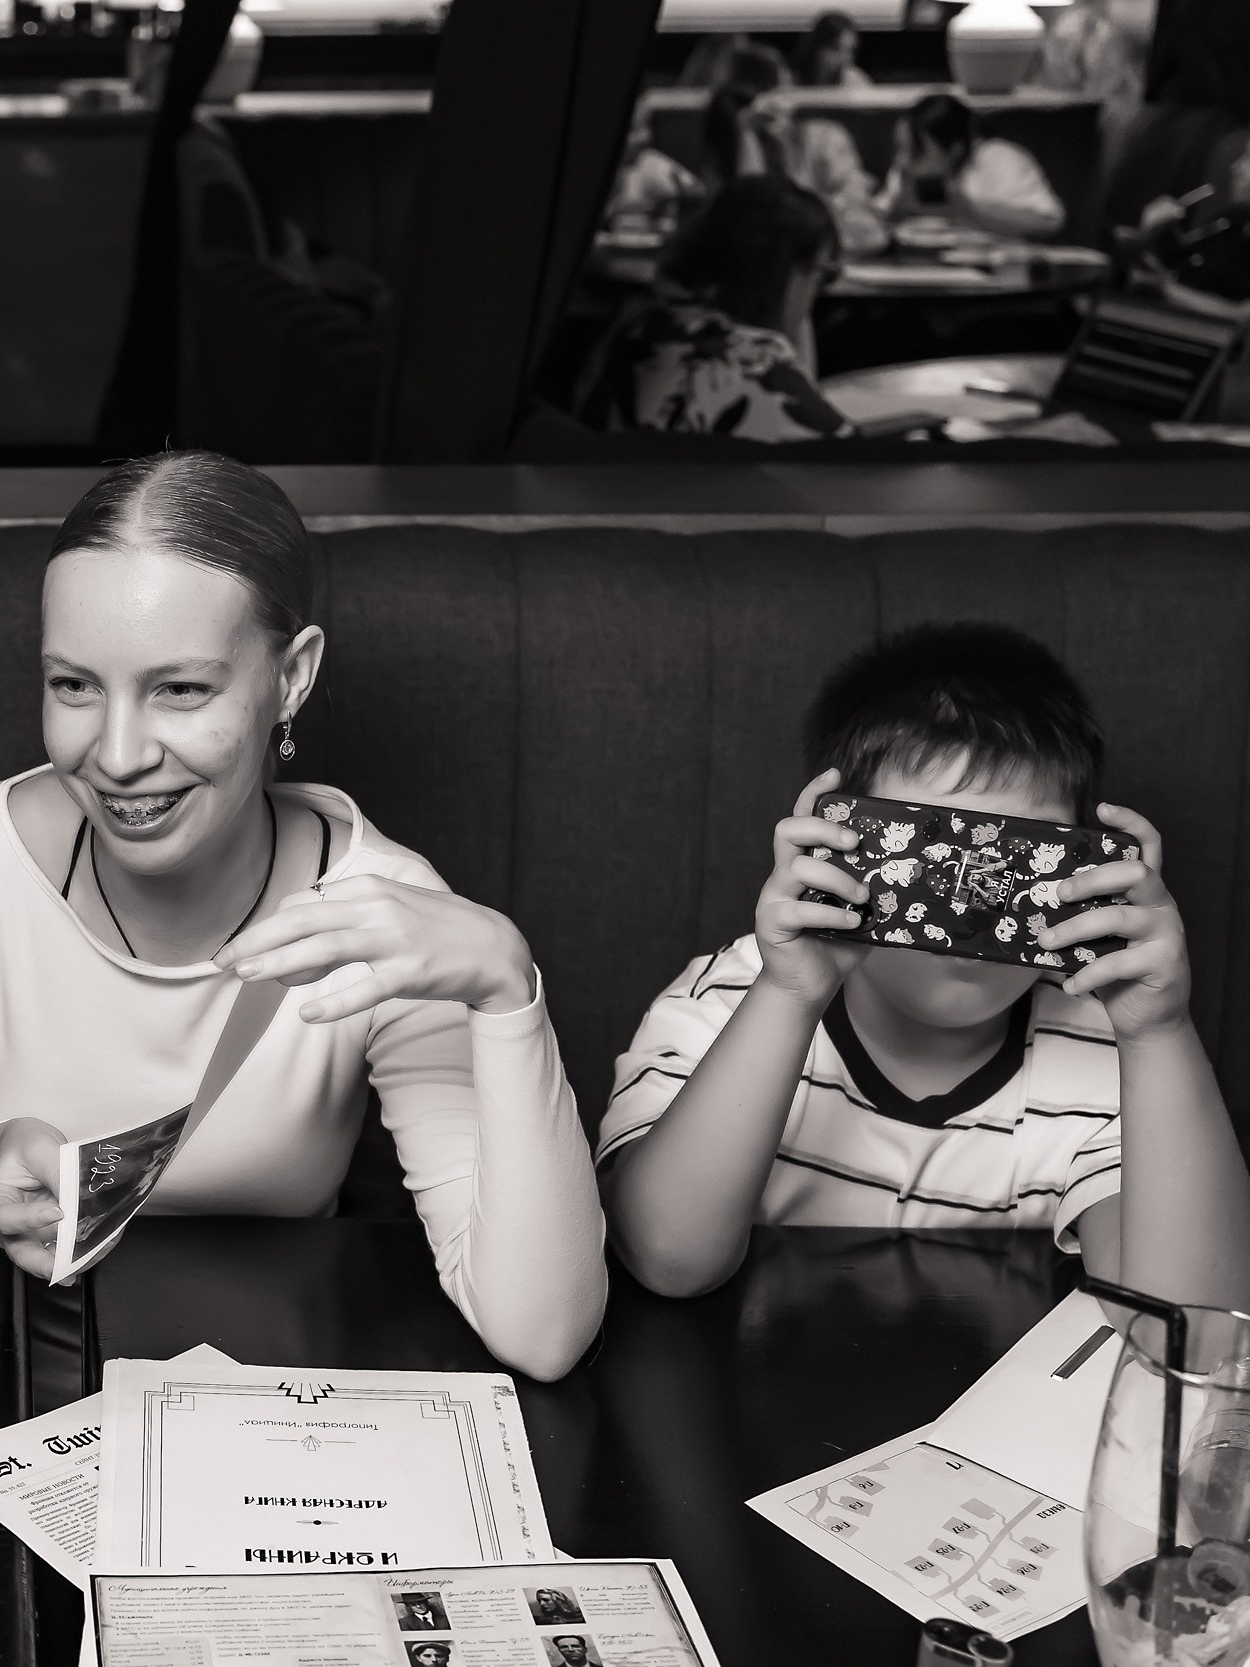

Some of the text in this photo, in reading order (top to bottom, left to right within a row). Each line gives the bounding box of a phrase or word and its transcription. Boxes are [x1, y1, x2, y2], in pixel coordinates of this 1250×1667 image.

[991, 880, 999, 890] Я
[996, 871, 1012, 903] УСТАЛ
[89, 1143, 122, 1193] 1923
[239, 1419, 378, 1430] Типография "Инициал"
[18, 1472, 84, 1501] МИРОВЫЕ НОВОСТИ
[243, 1496, 387, 1509] АДРЕСНАЯ КНИГА
[244, 1548, 398, 1565] И ОКРАИНЫ
[383, 1575, 453, 1590] Информаторы
